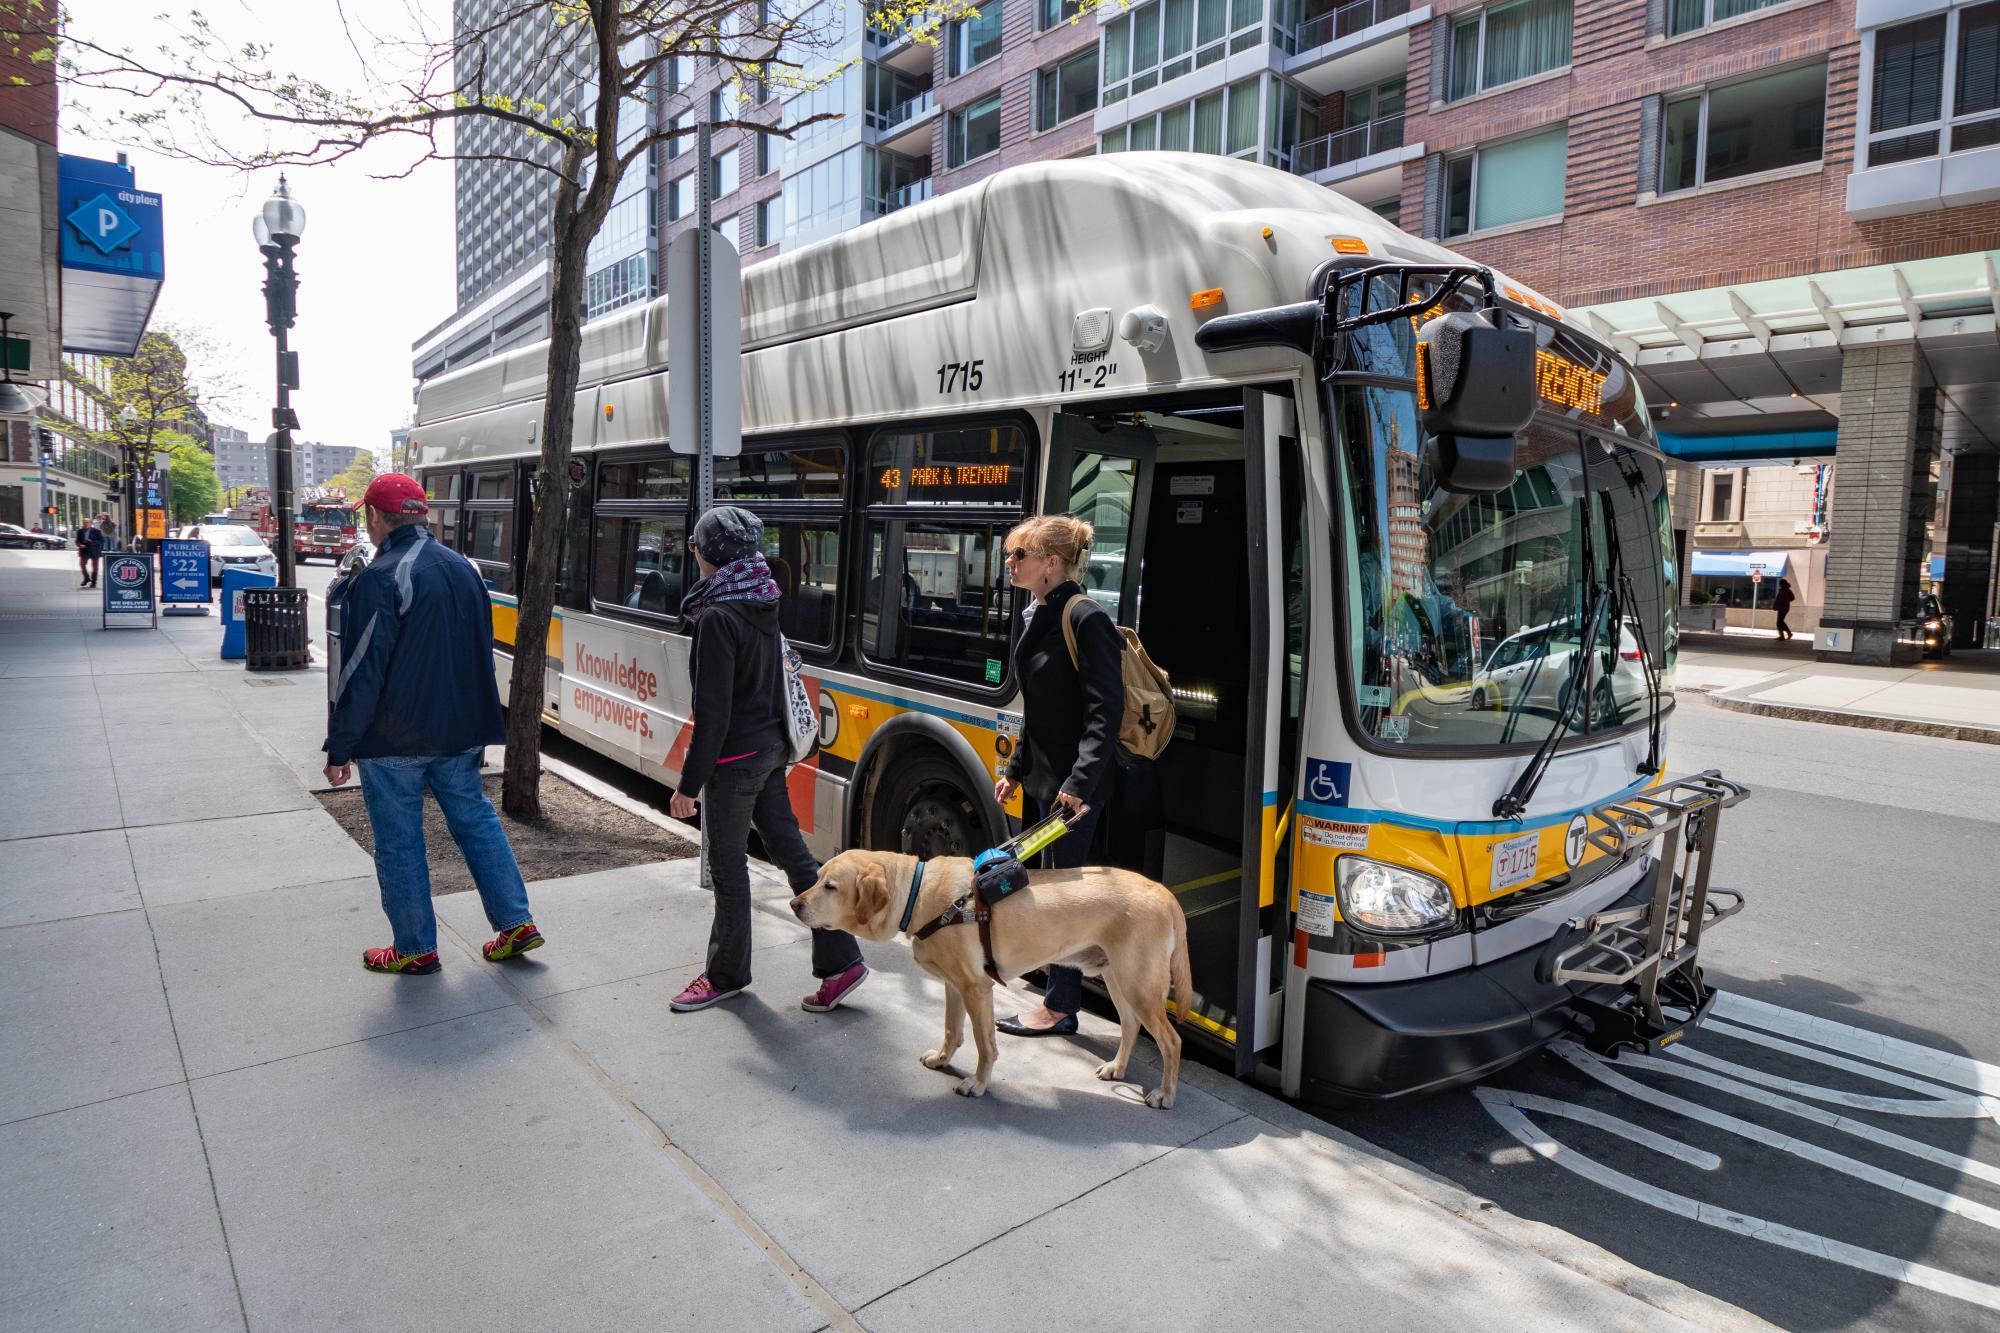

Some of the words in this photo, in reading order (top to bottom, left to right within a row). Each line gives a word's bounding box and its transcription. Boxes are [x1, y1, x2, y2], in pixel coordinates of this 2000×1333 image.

[118, 191, 134, 203] city
[135, 194, 159, 206] place
[99, 208, 118, 237] P
[1071, 351, 1107, 365] HEIGHT
[937, 360, 984, 394] 1715
[881, 469, 901, 487] 43
[911, 468, 939, 485] PARK
[943, 467, 952, 485] &
[957, 465, 1010, 484] TREMONT
[121, 566, 137, 579] JJ
[172, 559, 198, 571] $22
[576, 642, 657, 702] Knowledge
[574, 687, 654, 739] empowers.
[1315, 820, 1366, 833] WARNING
[1570, 827, 1584, 860] T
[1500, 858, 1508, 872] T
[1511, 845, 1537, 873] 1715
